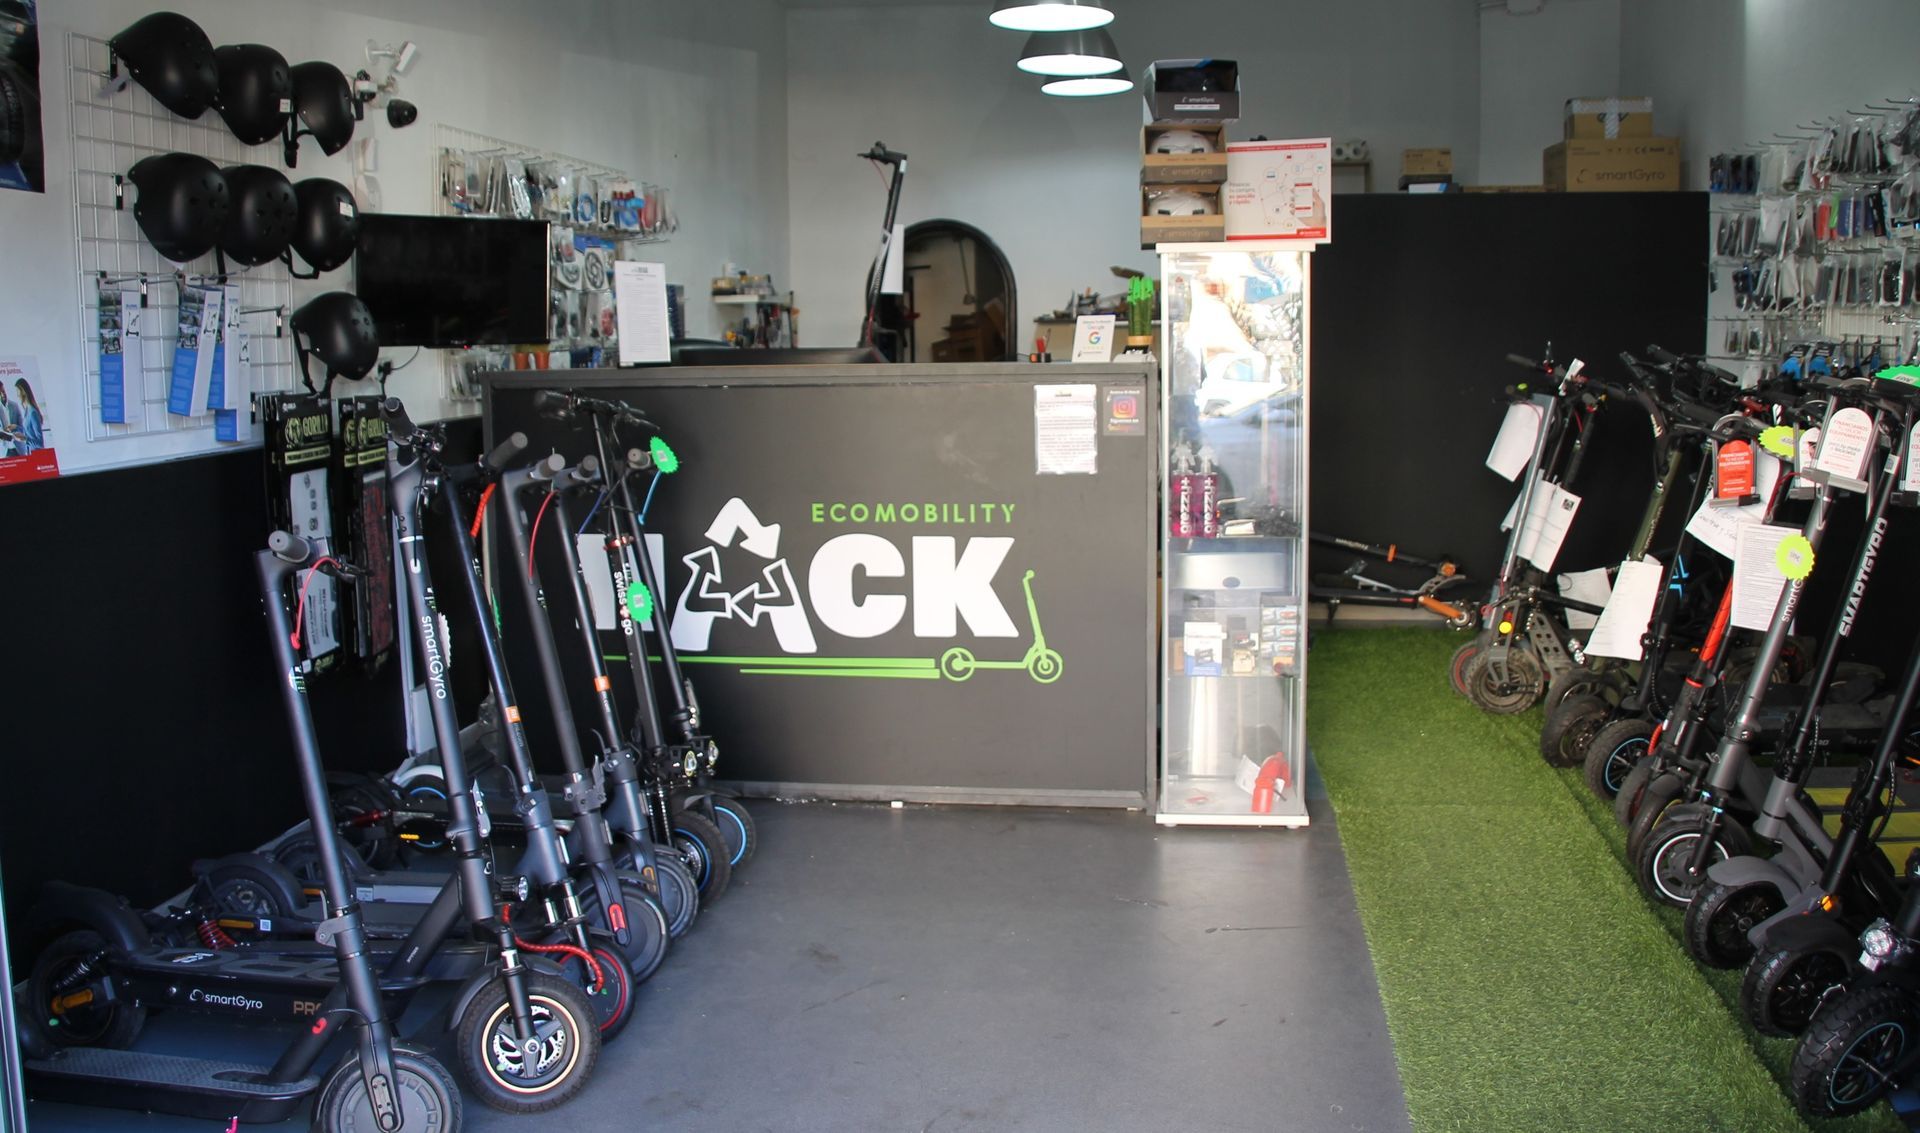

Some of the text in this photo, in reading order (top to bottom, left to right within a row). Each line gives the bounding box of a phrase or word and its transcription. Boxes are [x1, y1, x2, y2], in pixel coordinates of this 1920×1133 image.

[1595, 168, 1665, 182] smartGyro
[811, 503, 1016, 524] ECOMOBILITY
[1838, 516, 1888, 638] SMARTGYRO
[614, 571, 634, 636] swiss go
[421, 615, 447, 700] smartGyro
[205, 993, 263, 1010] smartGyro
